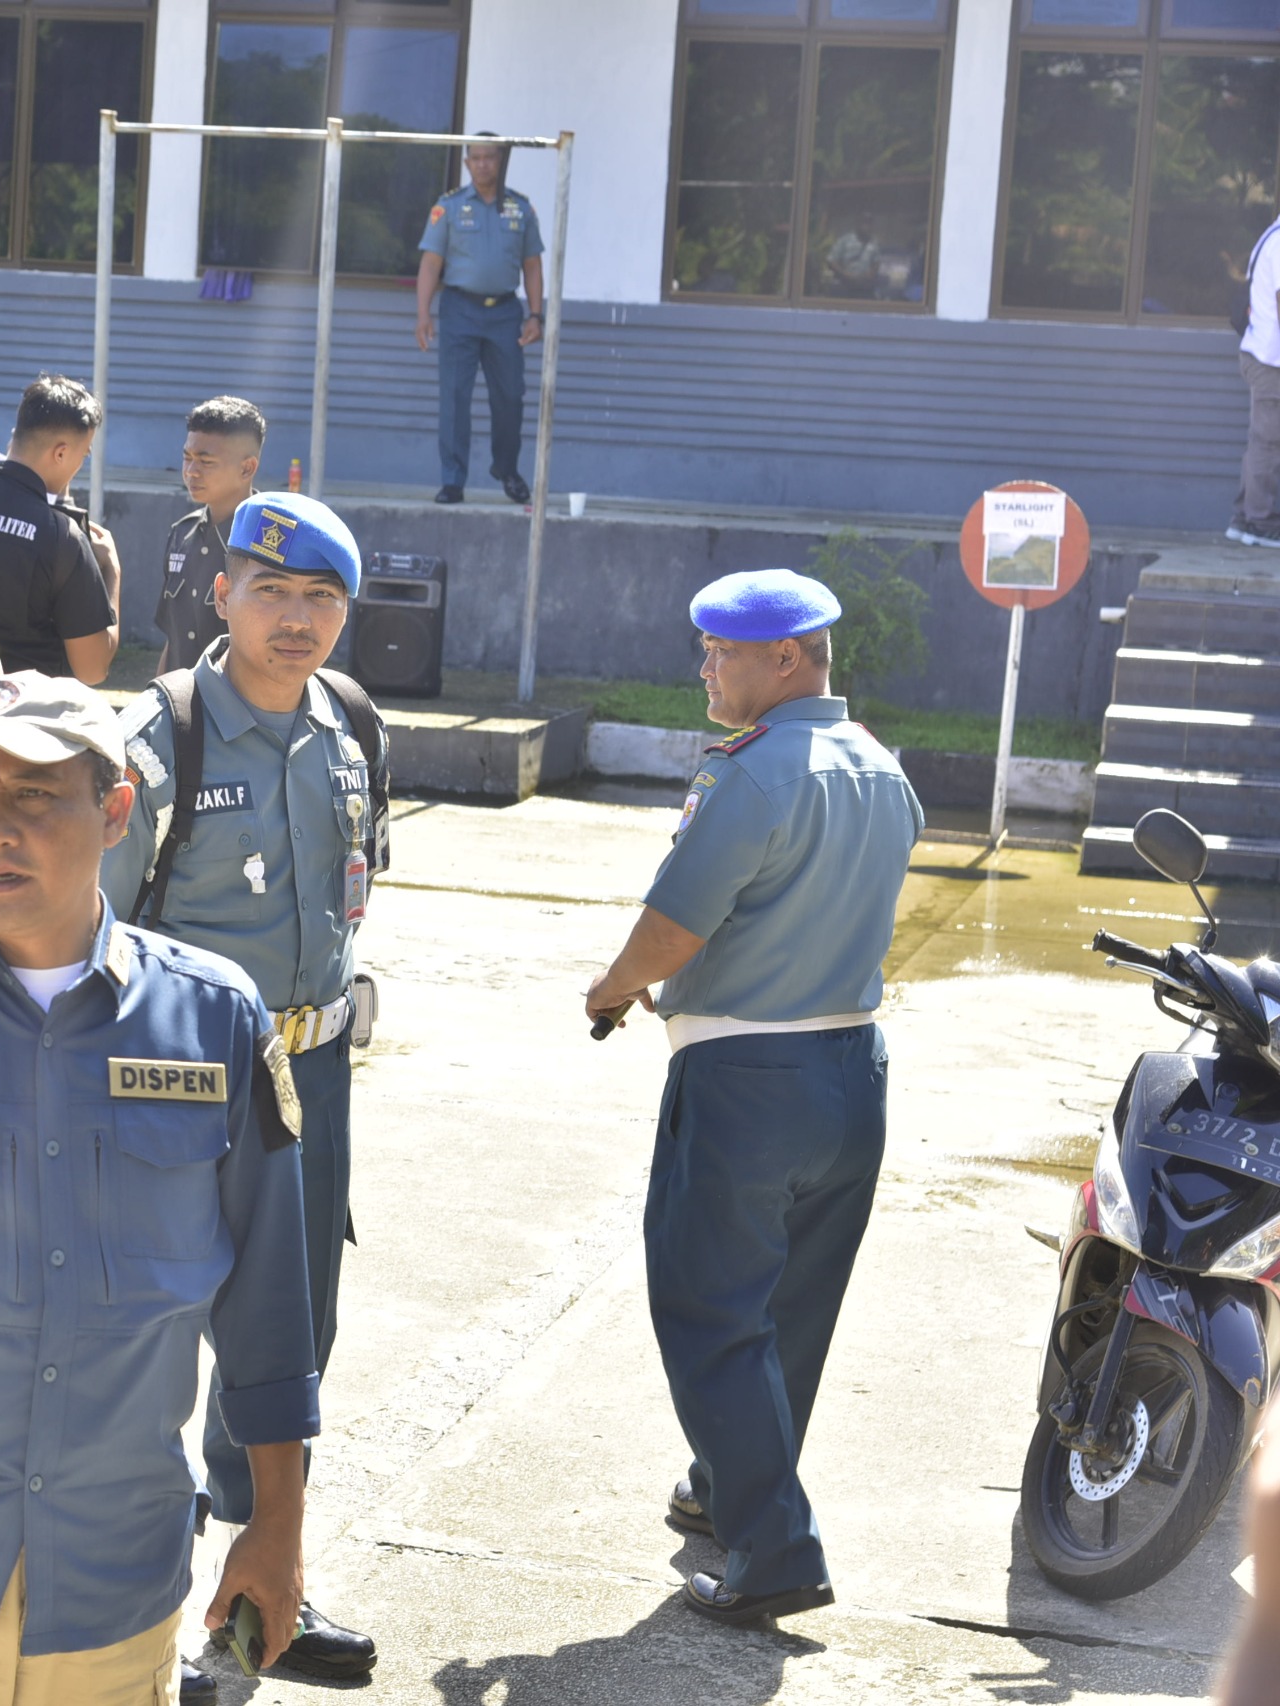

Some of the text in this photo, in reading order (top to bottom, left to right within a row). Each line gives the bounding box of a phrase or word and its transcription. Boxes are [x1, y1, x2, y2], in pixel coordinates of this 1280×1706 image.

[994, 503, 1054, 512] STARLIGHT
[334, 769, 362, 791] TNI
[236, 786, 244, 806] F
[120, 1066, 216, 1094] DISPEN
